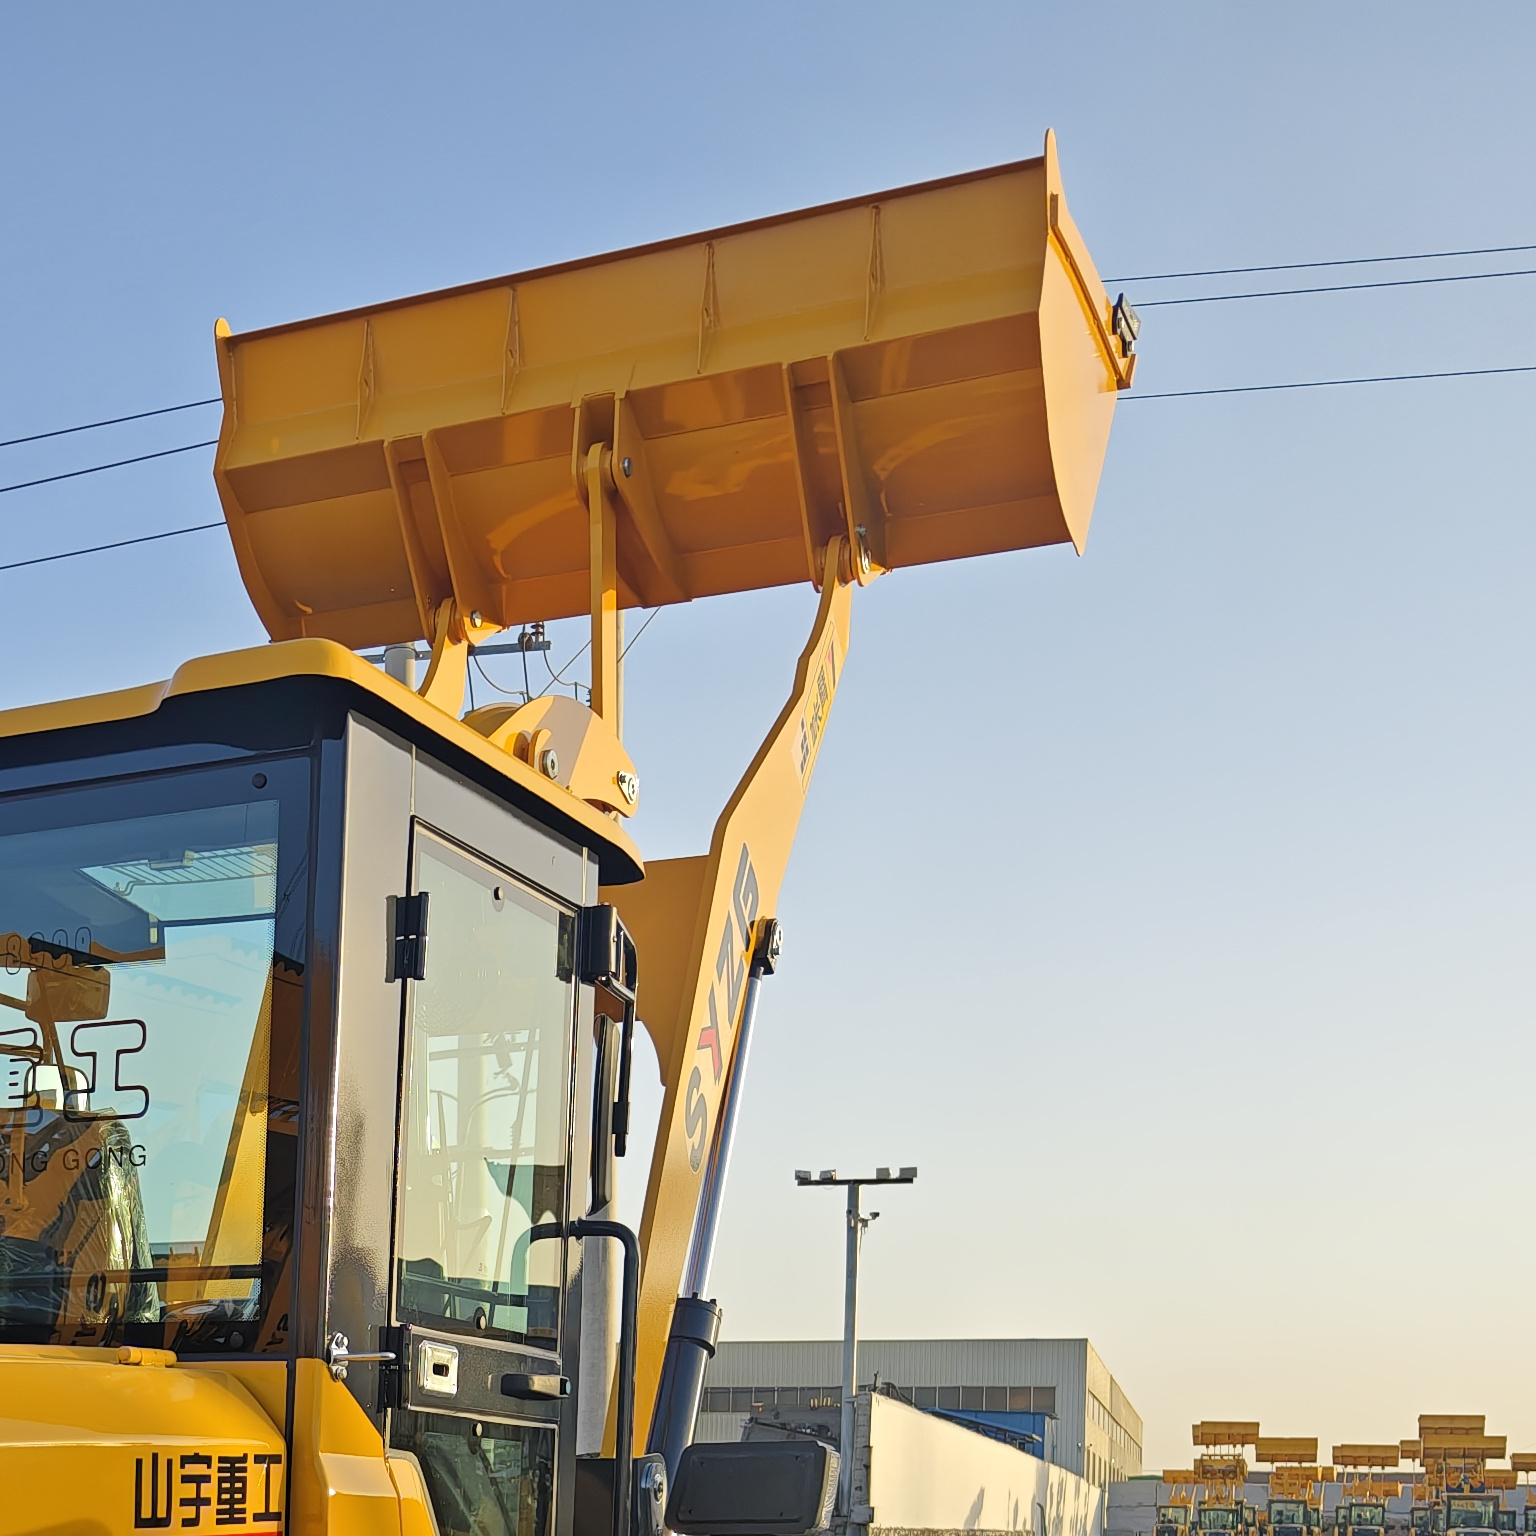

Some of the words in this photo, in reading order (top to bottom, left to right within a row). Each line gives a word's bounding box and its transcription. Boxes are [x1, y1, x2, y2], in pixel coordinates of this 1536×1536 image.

[685, 842, 760, 1173] SYZG
[62, 1144, 148, 1172] GONG
[134, 1452, 283, 1529] 山宇重工
